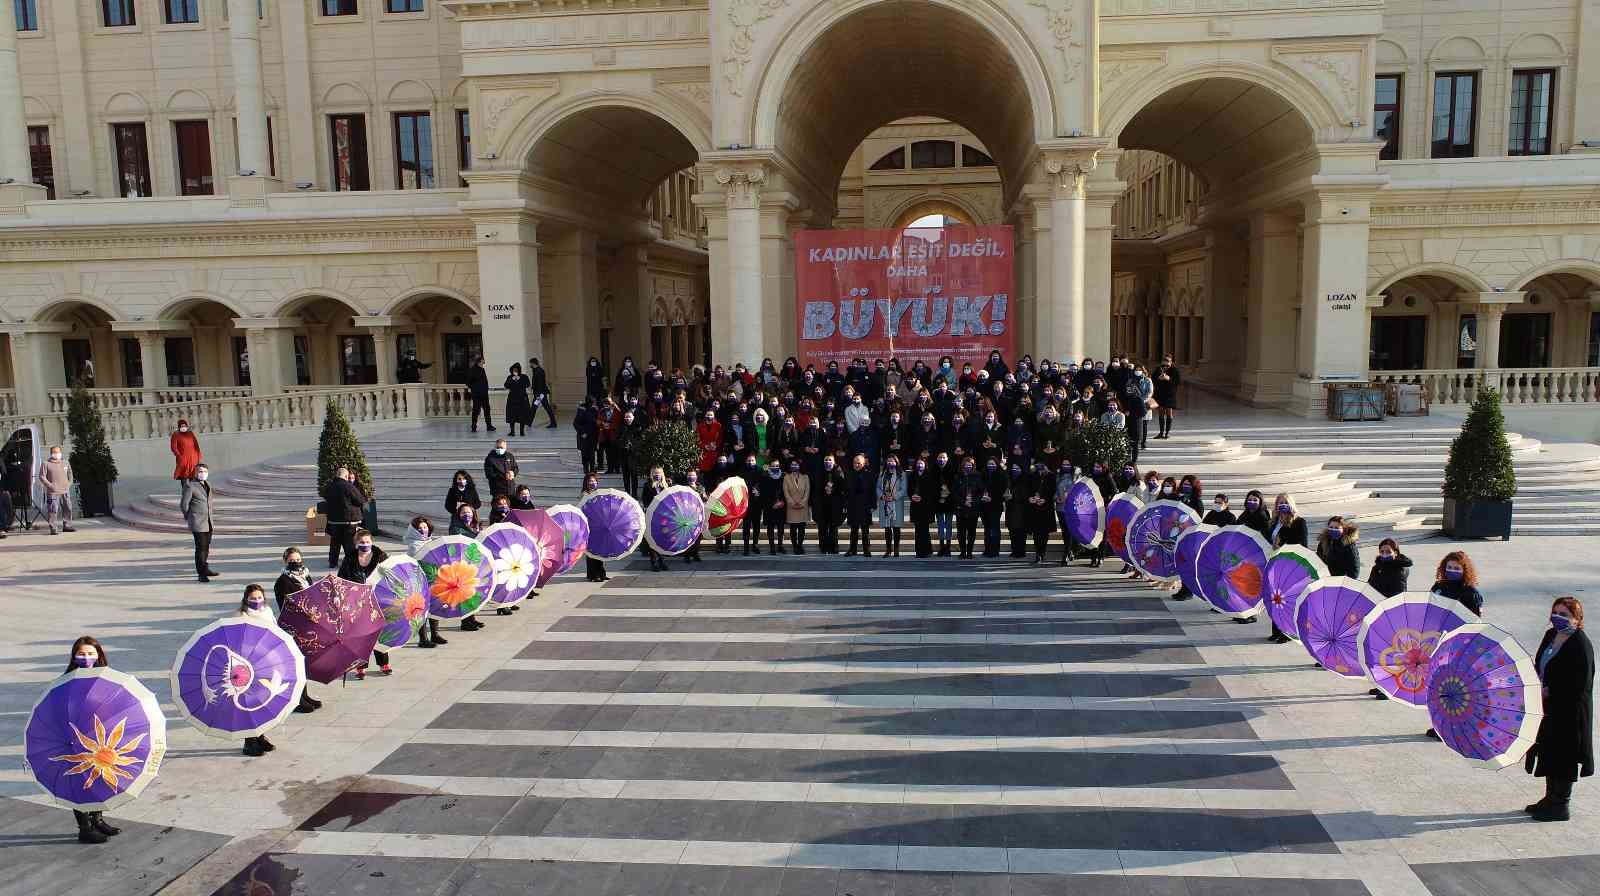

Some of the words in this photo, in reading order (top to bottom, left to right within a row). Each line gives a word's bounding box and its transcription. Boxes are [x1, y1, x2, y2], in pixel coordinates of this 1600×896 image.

[809, 245, 903, 263] KADINLAR
[948, 238, 1005, 257] DEĞİL,
[886, 265, 928, 277] DAHA
[1327, 293, 1357, 301] LOZAN
[800, 287, 1008, 340] BÜYÜK!
